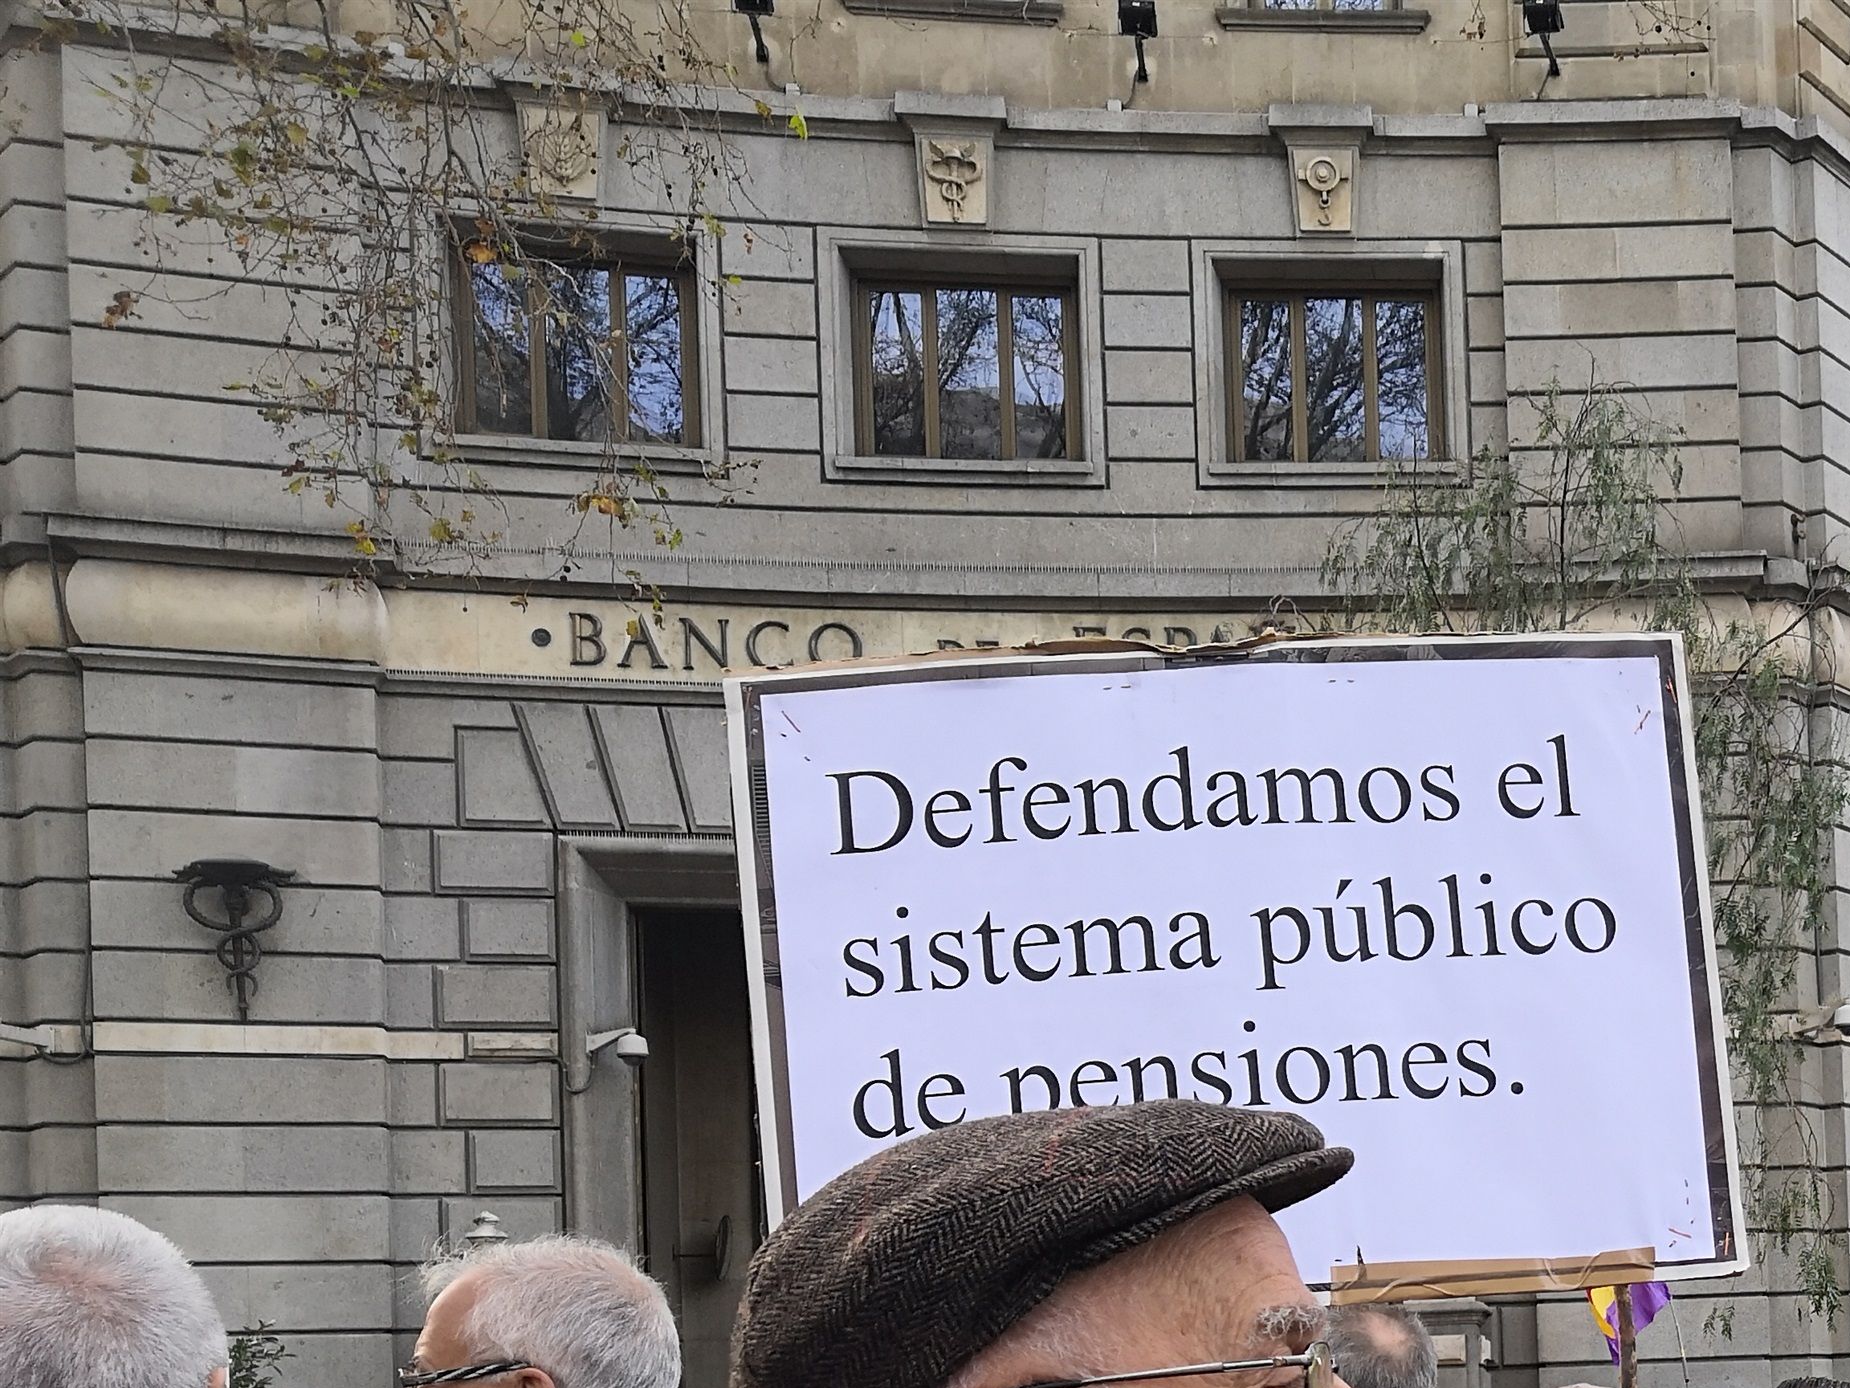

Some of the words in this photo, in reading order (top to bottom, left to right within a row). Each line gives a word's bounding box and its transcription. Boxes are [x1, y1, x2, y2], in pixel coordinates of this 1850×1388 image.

[568, 611, 863, 670] BANCO
[825, 745, 1460, 855] Defendamos
[1498, 733, 1581, 819] el
[843, 905, 1221, 998] sistema
[1250, 872, 1617, 990] público
[852, 1049, 967, 1140] de
[1002, 1020, 1524, 1115] pensiones.
